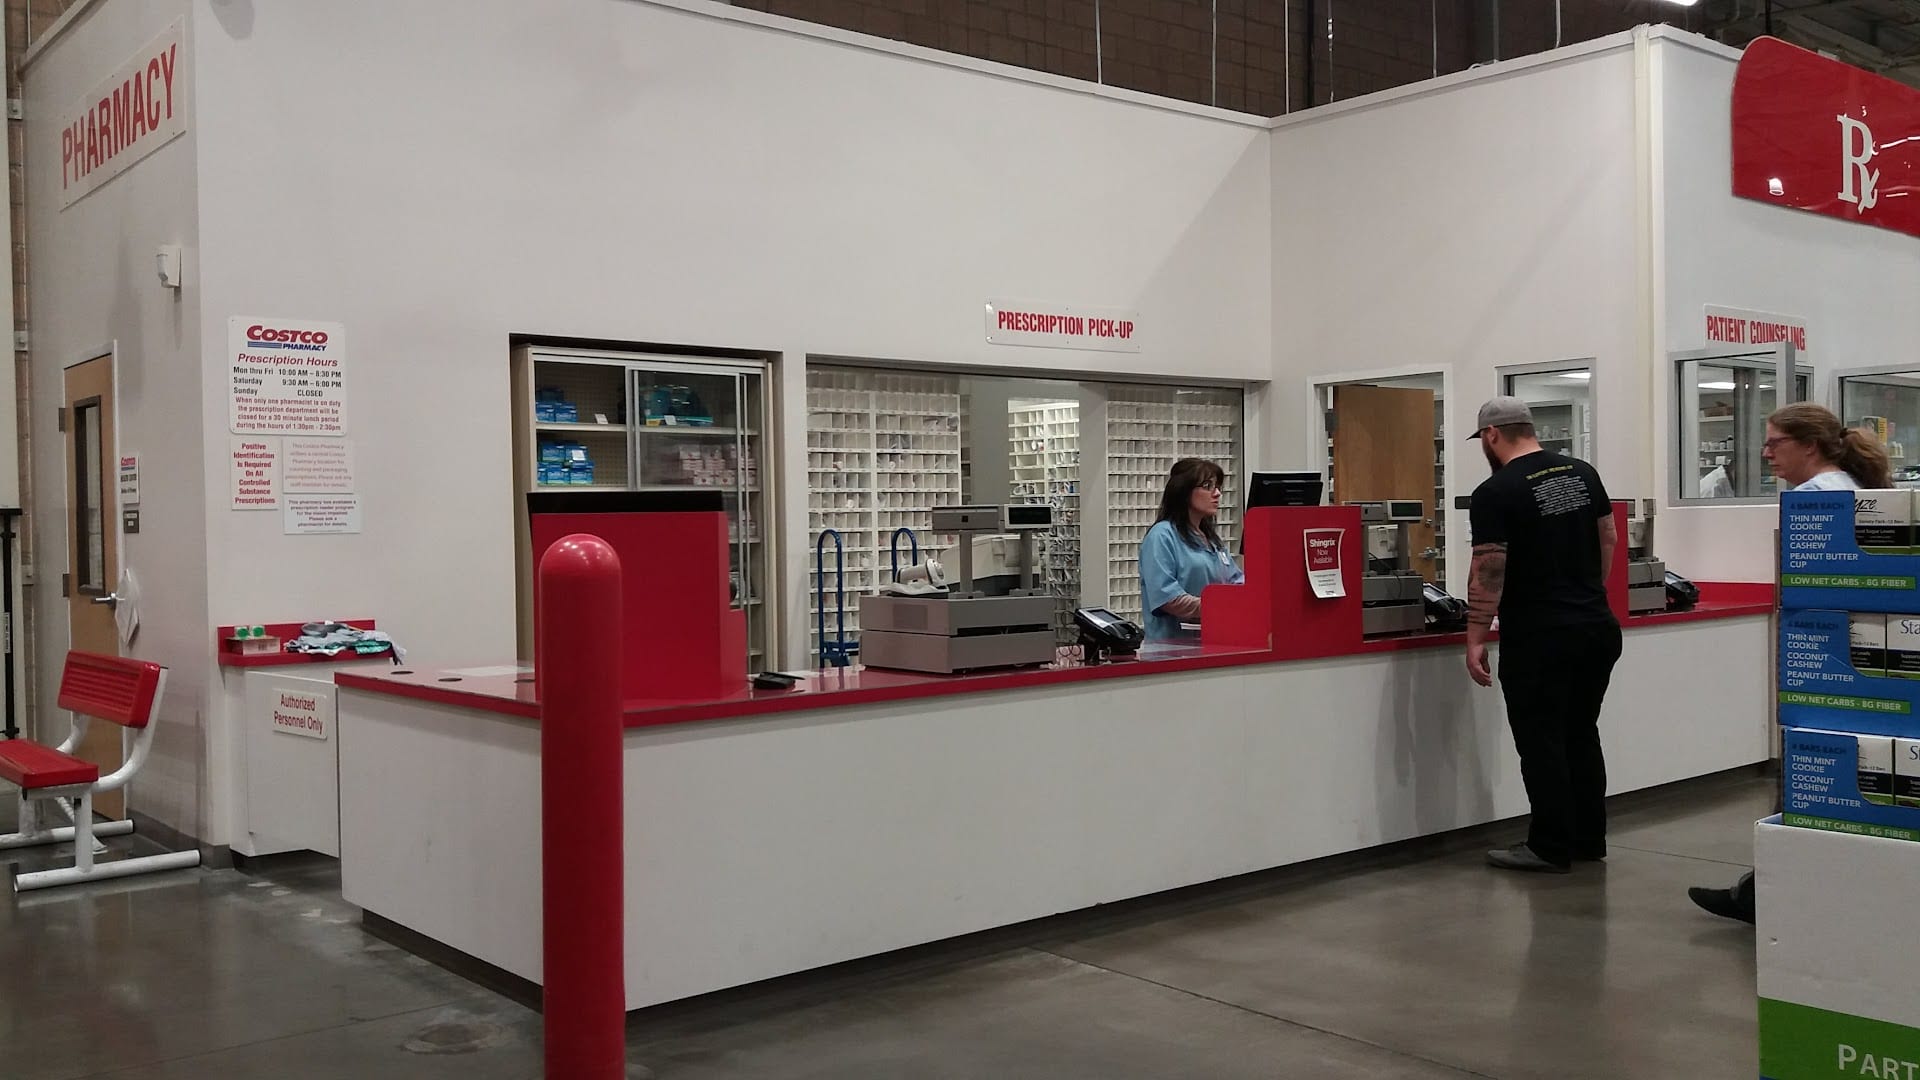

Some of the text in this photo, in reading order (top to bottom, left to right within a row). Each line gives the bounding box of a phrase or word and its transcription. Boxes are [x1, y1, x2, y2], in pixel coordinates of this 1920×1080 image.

[62, 43, 176, 190] PHARMACY
[998, 310, 1133, 339] PRESCRIPTION PICK-UP
[247, 325, 328, 344] COSTCO
[1707, 315, 1805, 351] PATIENT COUNSELING
[282, 343, 327, 352] PHARMACY
[238, 353, 338, 367] Prescription Hours
[233, 366, 248, 374] Mon
[250, 367, 262, 375] thru
[265, 367, 274, 375] Fri
[278, 368, 296, 376] 10:00
[298, 369, 308, 377] AM
[233, 376, 262, 386] Saturday
[331, 380, 342, 388] PM
[233, 386, 258, 396] Sunday
[236, 396, 252, 404] When
[254, 397, 266, 406] only
[280, 398, 312, 406] pharmacist
[329, 400, 341, 408] duty
[248, 406, 284, 414] prescription
[285, 406, 318, 414] department
[282, 414, 302, 422] minute
[236, 422, 256, 430] during
[1790, 514, 1834, 522] THIN MINT
[1309, 538, 1336, 548] Shingrix
[1790, 542, 1826, 550] CASHEW
[1317, 548, 1328, 556] Now
[1790, 552, 1823, 560] PEANUT
[1790, 560, 1807, 568] CUP
[1832, 578, 1859, 586] CARBS
[1881, 579, 1906, 587] FIBER
[1787, 633, 1806, 641] THIN
[1787, 642, 1820, 650] COOKIE
[1787, 652, 1829, 661] COCONUT
[1787, 660, 1822, 668] CASHEW
[1787, 671, 1854, 682] PEANUT BUTTER
[1787, 678, 1804, 686] CUP
[280, 694, 316, 712] Authorized
[1788, 694, 1806, 702] LOW
[1808, 696, 1826, 704] NET
[1826, 698, 1854, 706] CARBS
[1876, 702, 1902, 710] FIBER
[274, 711, 322, 735] Personnel Only
[1792, 755, 1836, 766] THIN MINT
[1792, 764, 1825, 773] COOKIE
[1792, 775, 1835, 784] COCONUT
[1792, 783, 1828, 792] CASHEW
[1792, 793, 1861, 808] PEANUT BUTTER
[1792, 801, 1810, 809] CUP
[1793, 817, 1812, 826] LOW
[1815, 820, 1832, 828] NET
[1834, 823, 1862, 832] CARBS
[1884, 828, 1911, 839] FIBER
[1838, 1043, 1919, 1080] PART
